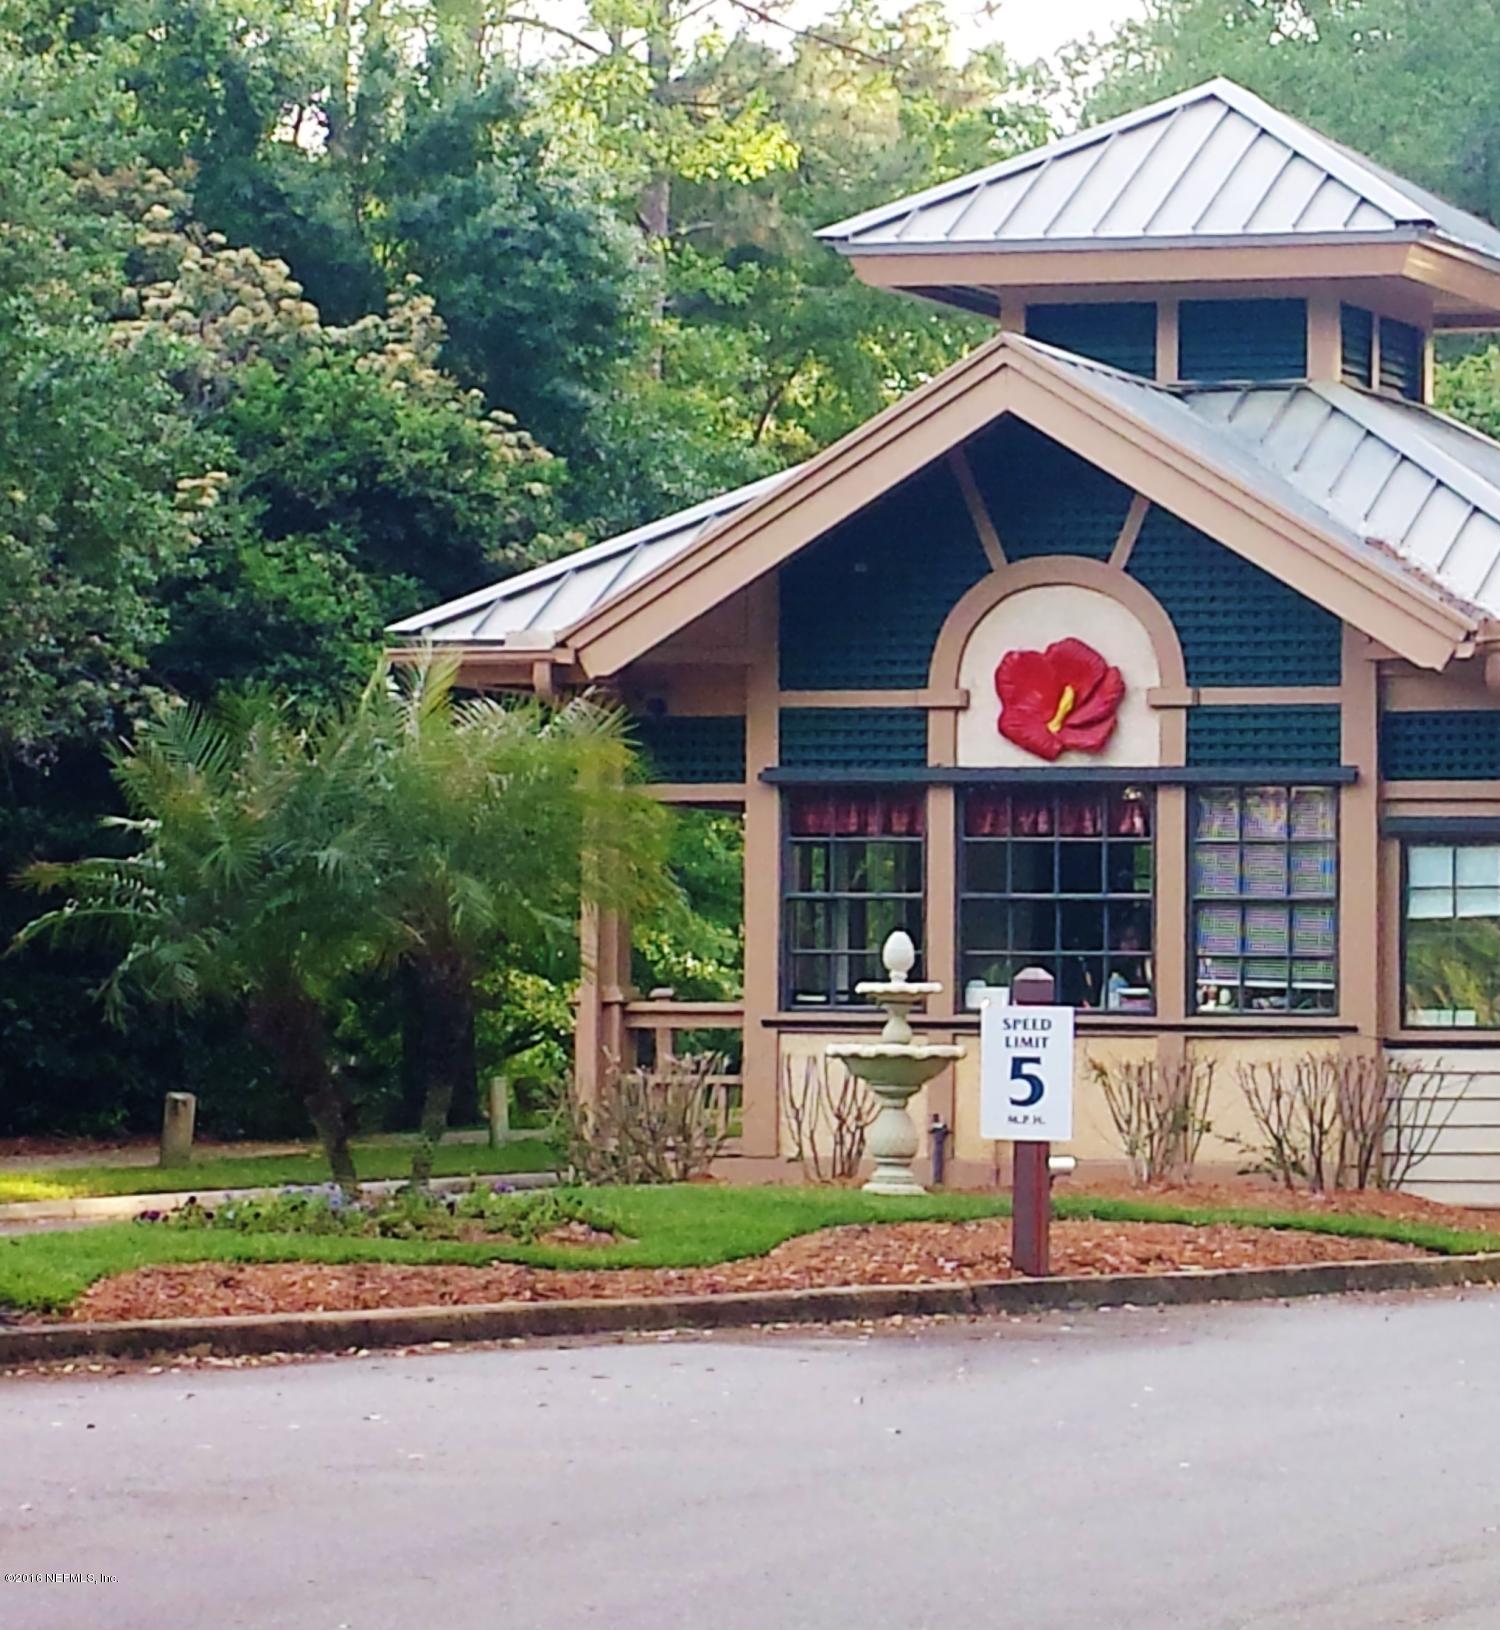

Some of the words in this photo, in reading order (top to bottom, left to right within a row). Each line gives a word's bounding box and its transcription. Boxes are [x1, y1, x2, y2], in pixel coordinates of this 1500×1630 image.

[1003, 1018, 1052, 1031] SPEED
[1005, 1036, 1049, 1048] LIMIT
[1009, 1056, 1044, 1107] 5
